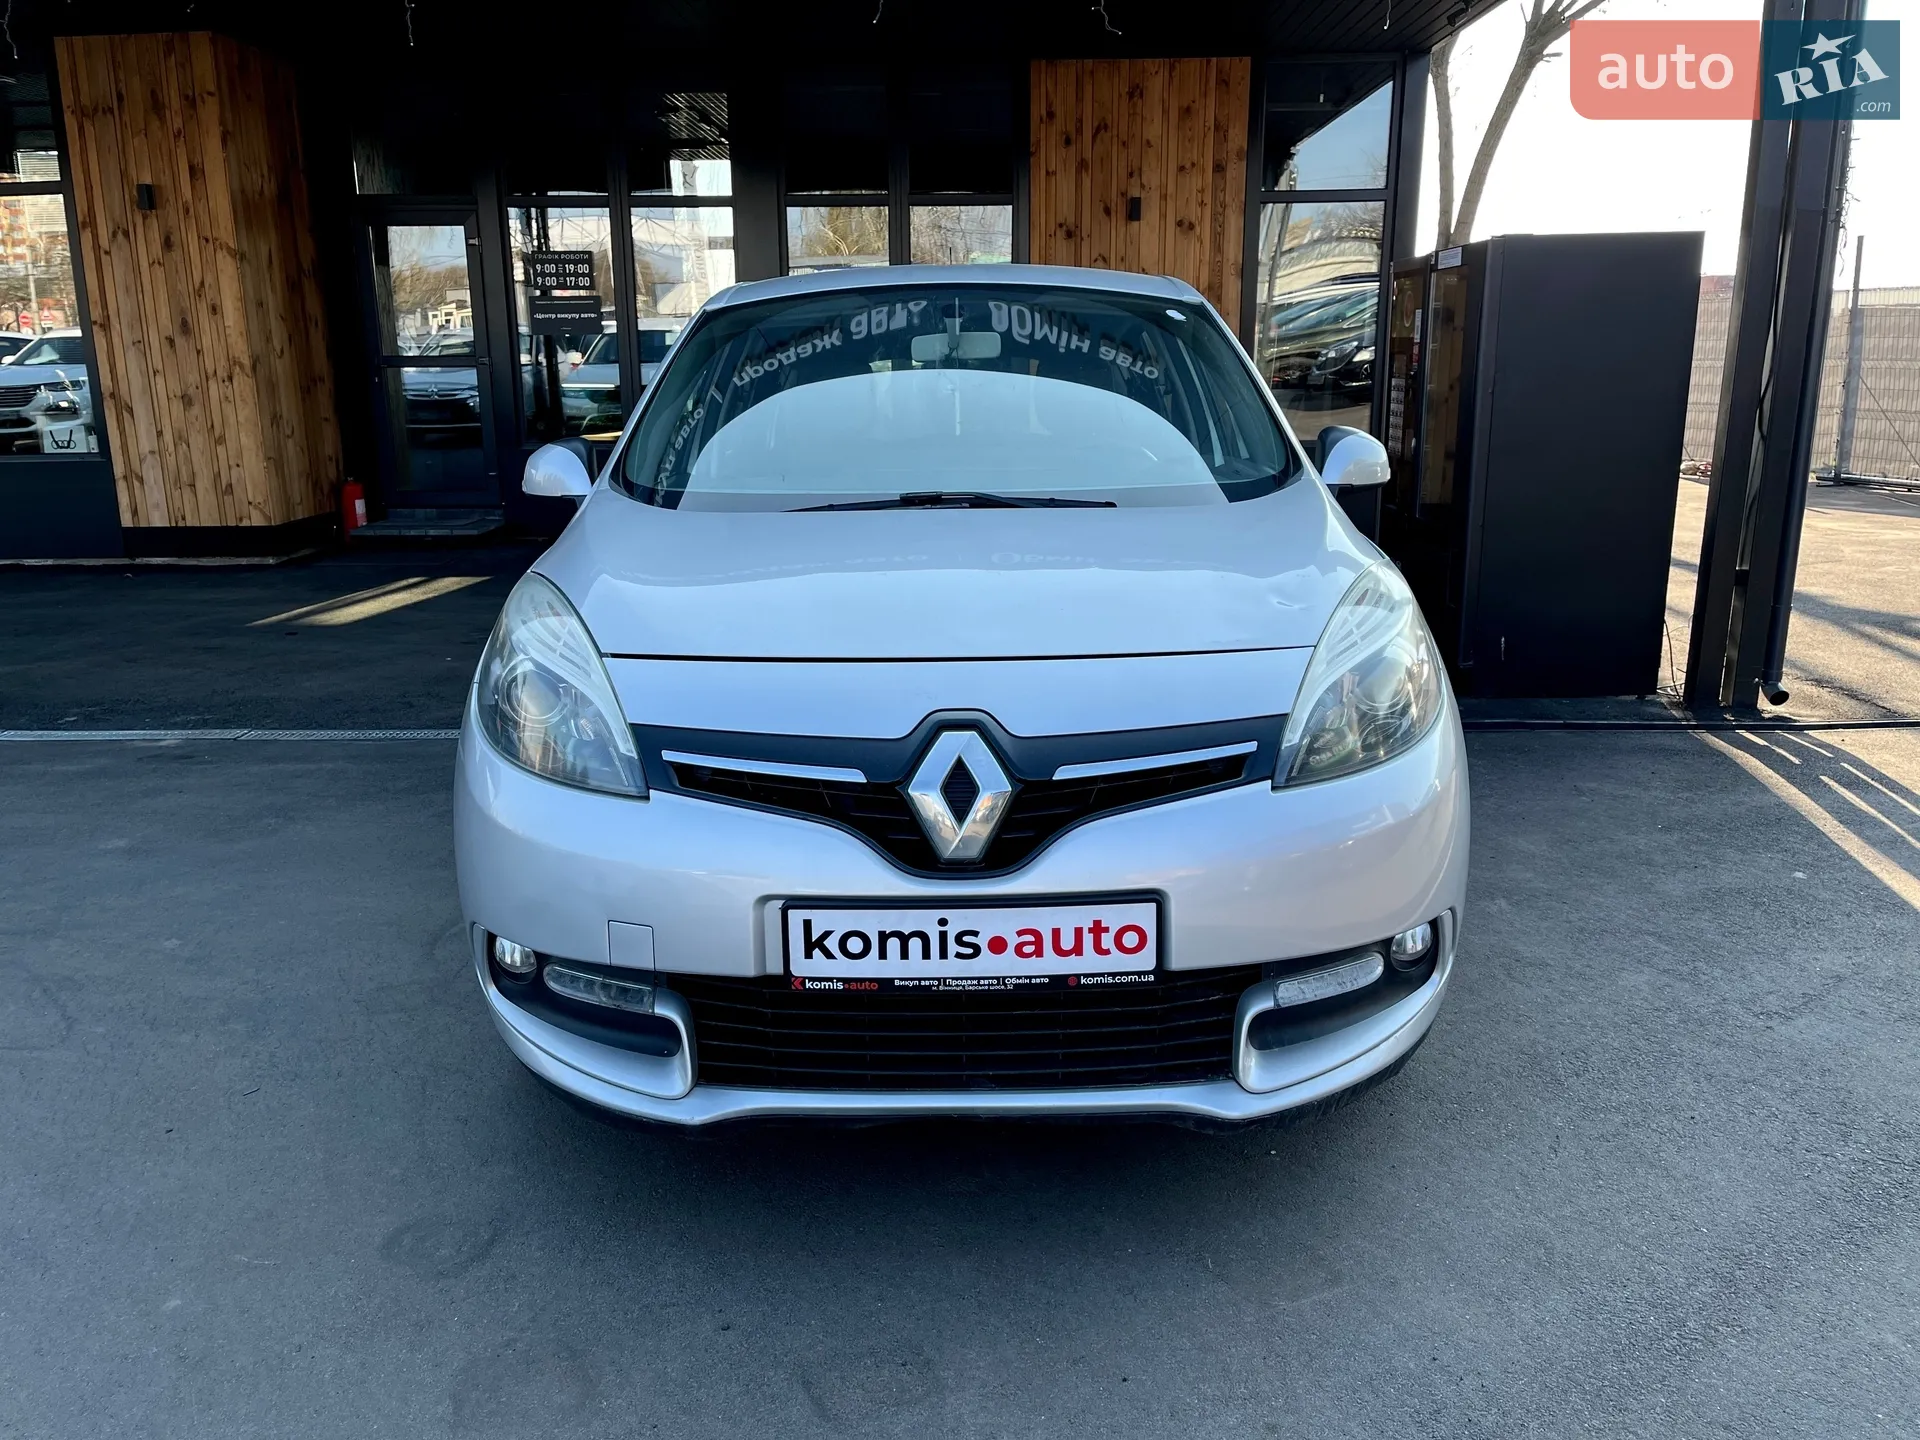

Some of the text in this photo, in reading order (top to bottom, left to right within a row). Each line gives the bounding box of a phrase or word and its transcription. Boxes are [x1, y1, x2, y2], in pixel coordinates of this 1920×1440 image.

[535, 263, 589, 274] 9:00 19:00
[536, 276, 590, 287] 9:00 17:00
[894, 979, 919, 987] Викуп
[946, 979, 978, 988] Продаж
[1005, 977, 1030, 985] Обмін
[1080, 974, 1155, 985] komis.com.ua
